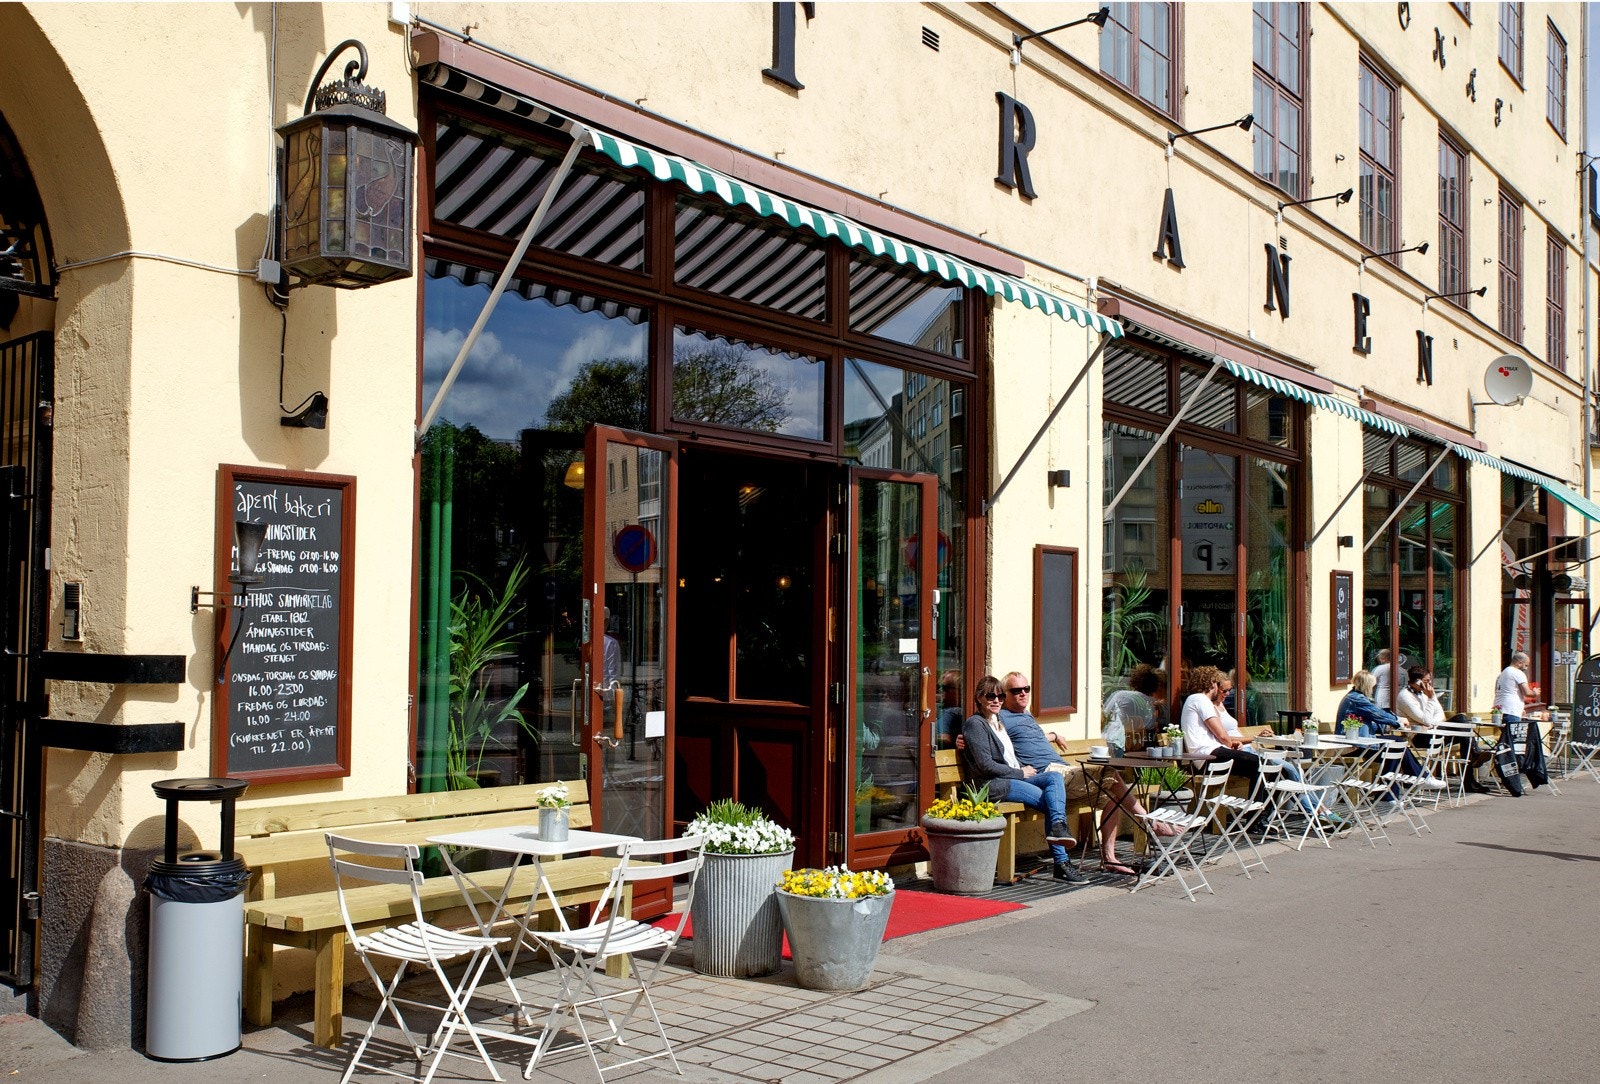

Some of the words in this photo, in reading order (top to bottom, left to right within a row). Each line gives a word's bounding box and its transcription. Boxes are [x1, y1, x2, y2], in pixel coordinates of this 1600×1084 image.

[284, 493, 331, 518] bakeri
[278, 594, 333, 609] SAMVIRKELAG
[290, 612, 310, 623] 1862
[245, 622, 314, 639] ÅPNINGSTIDER
[242, 642, 277, 654] MANDAG
[280, 641, 292, 651] OG
[263, 653, 297, 664] STENGT
[264, 671, 296, 681] TORSDAG
[298, 670, 309, 680] OG
[237, 701, 274, 713] FREDAG
[276, 699, 289, 710] OG
[247, 714, 270, 727] 16.00
[284, 710, 311, 722] 24.00
[291, 730, 306, 739] ER
[249, 745, 267, 755] TIL
